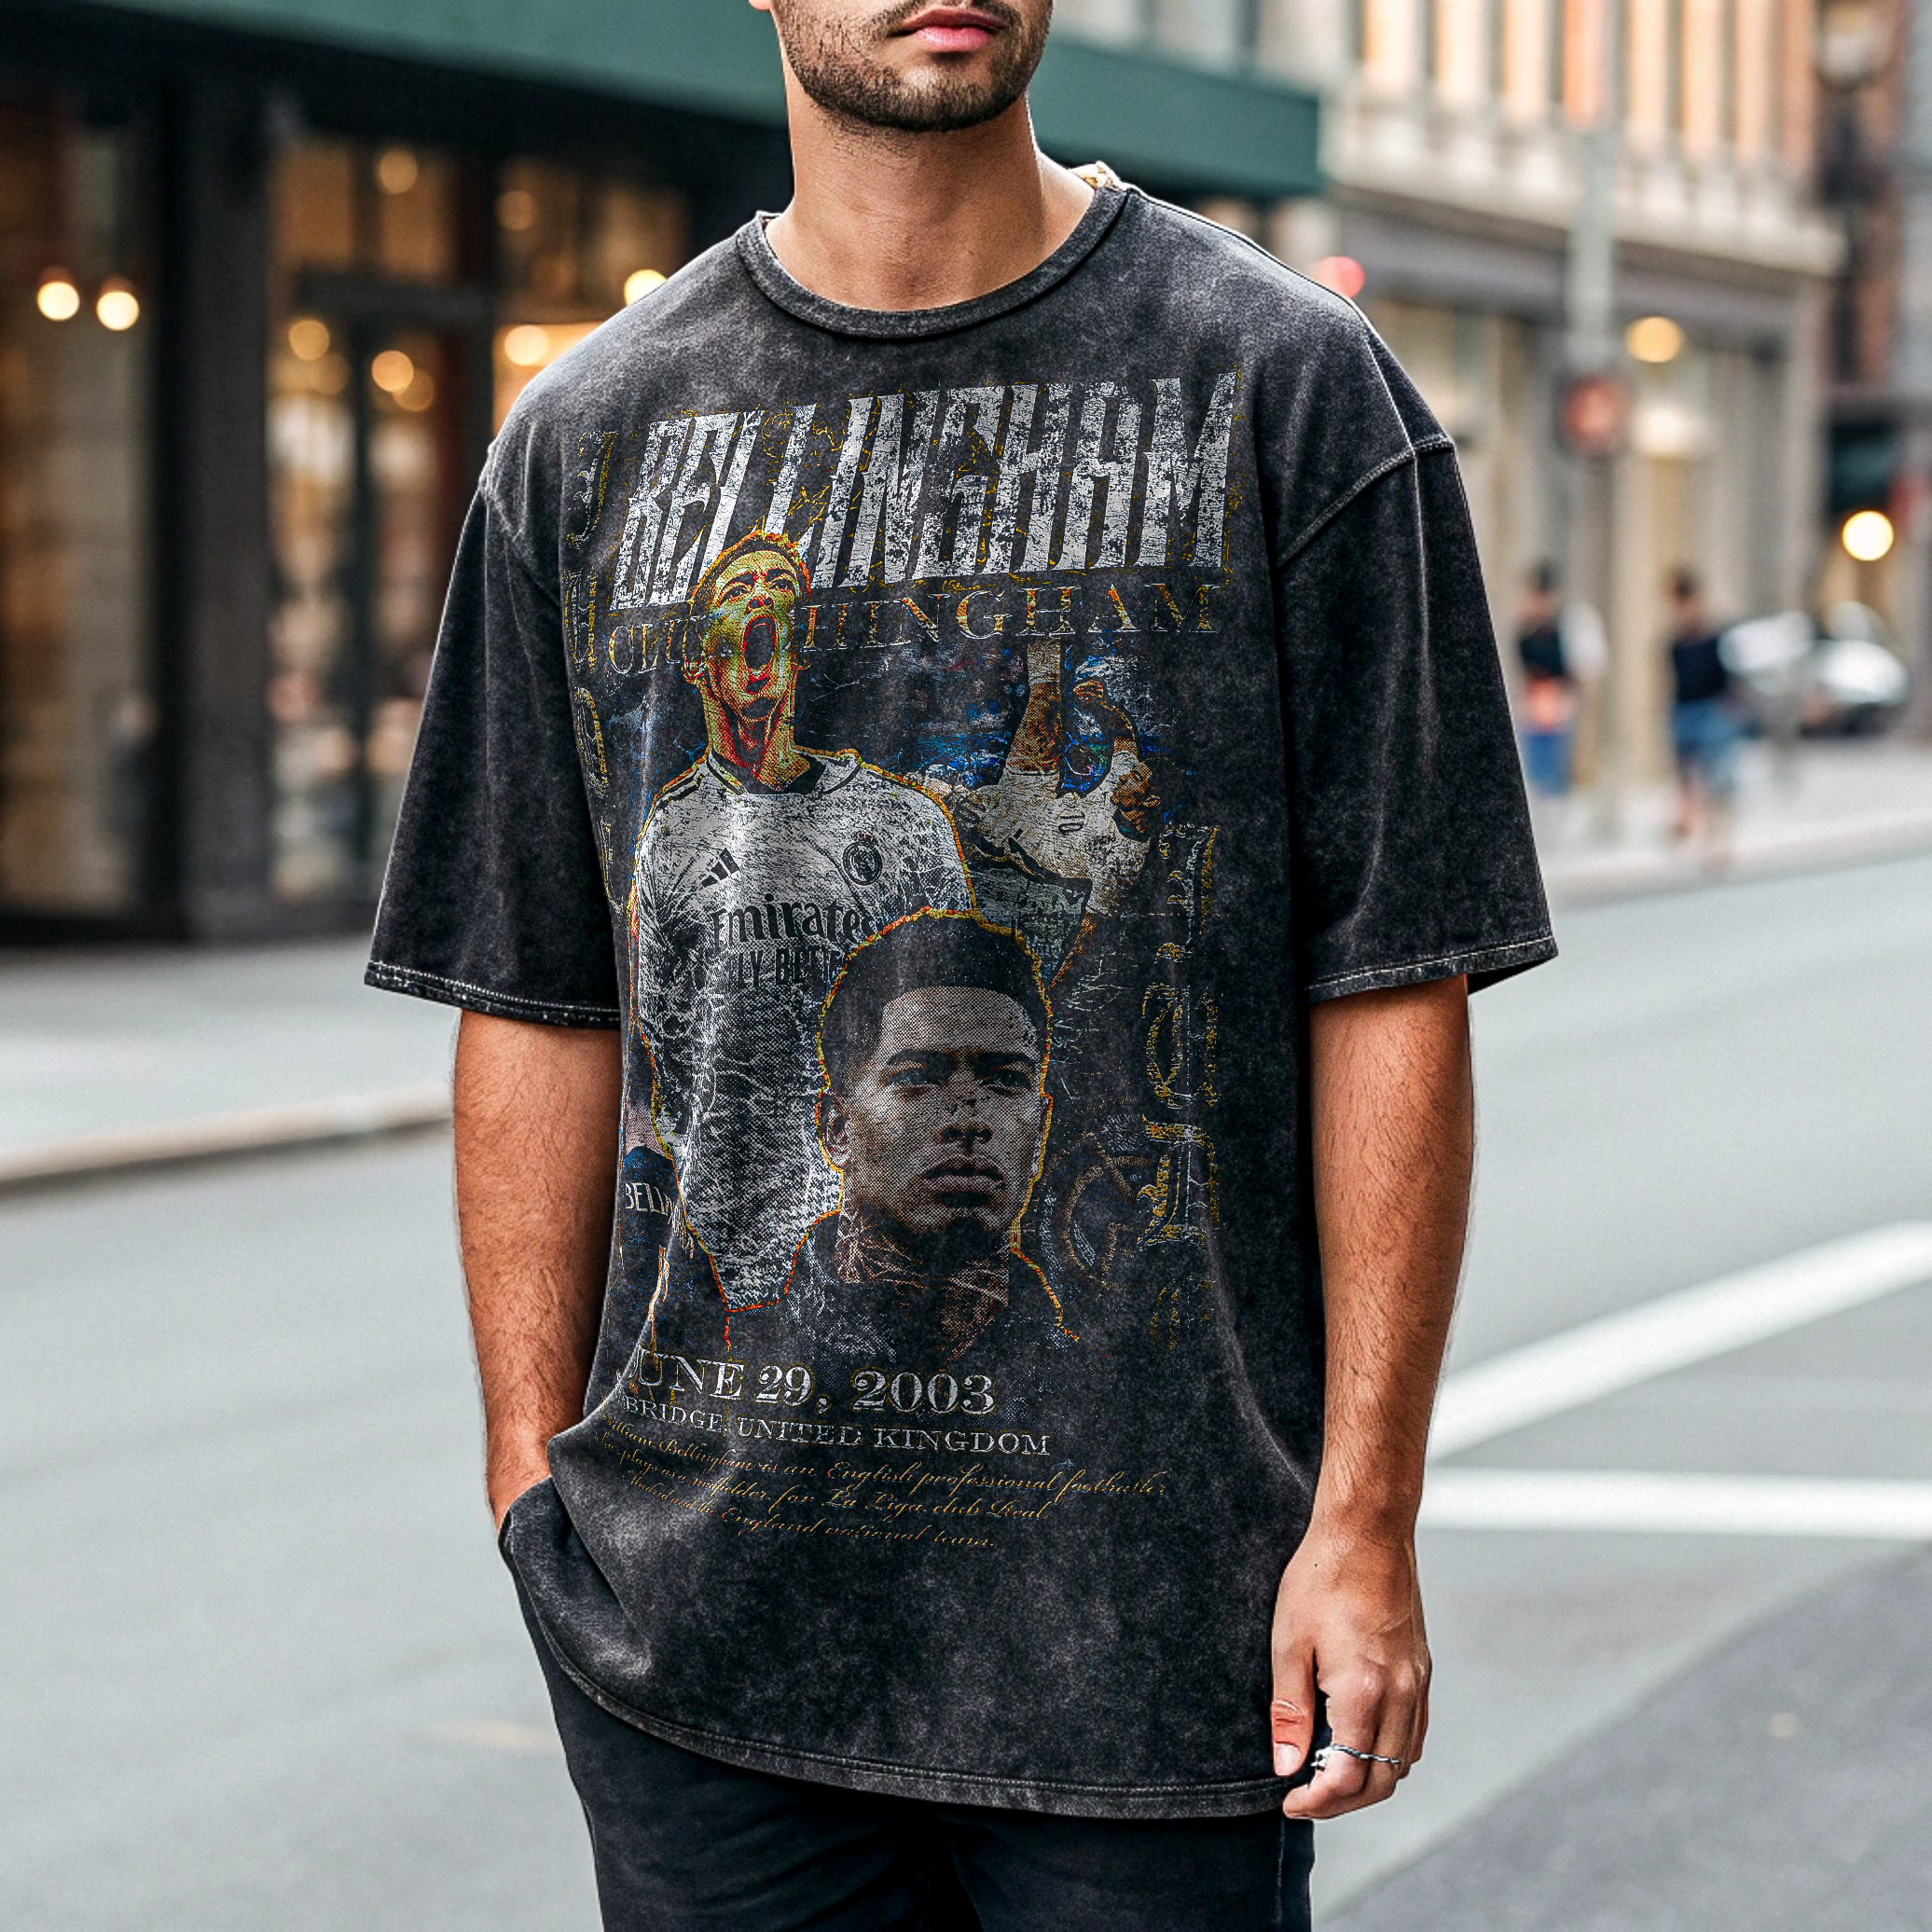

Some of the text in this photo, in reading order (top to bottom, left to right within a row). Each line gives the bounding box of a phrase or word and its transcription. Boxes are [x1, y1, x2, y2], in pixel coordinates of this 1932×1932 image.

[755, 1364, 828, 1414] 29,
[853, 1370, 997, 1415] 2003
[737, 1416, 862, 1446] UNITED
[873, 1427, 1051, 1456] KINGDOM
[617, 1448, 658, 1476] plays
[767, 1484, 815, 1514] for
[821, 1488, 857, 1509] La
[933, 1497, 984, 1517] club
[986, 1499, 1052, 1521] Real
[827, 1459, 921, 1492] English
[908, 1463, 1062, 1497] professional
[1055, 1470, 1170, 1505] footballer
[722, 1504, 827, 1536] England
